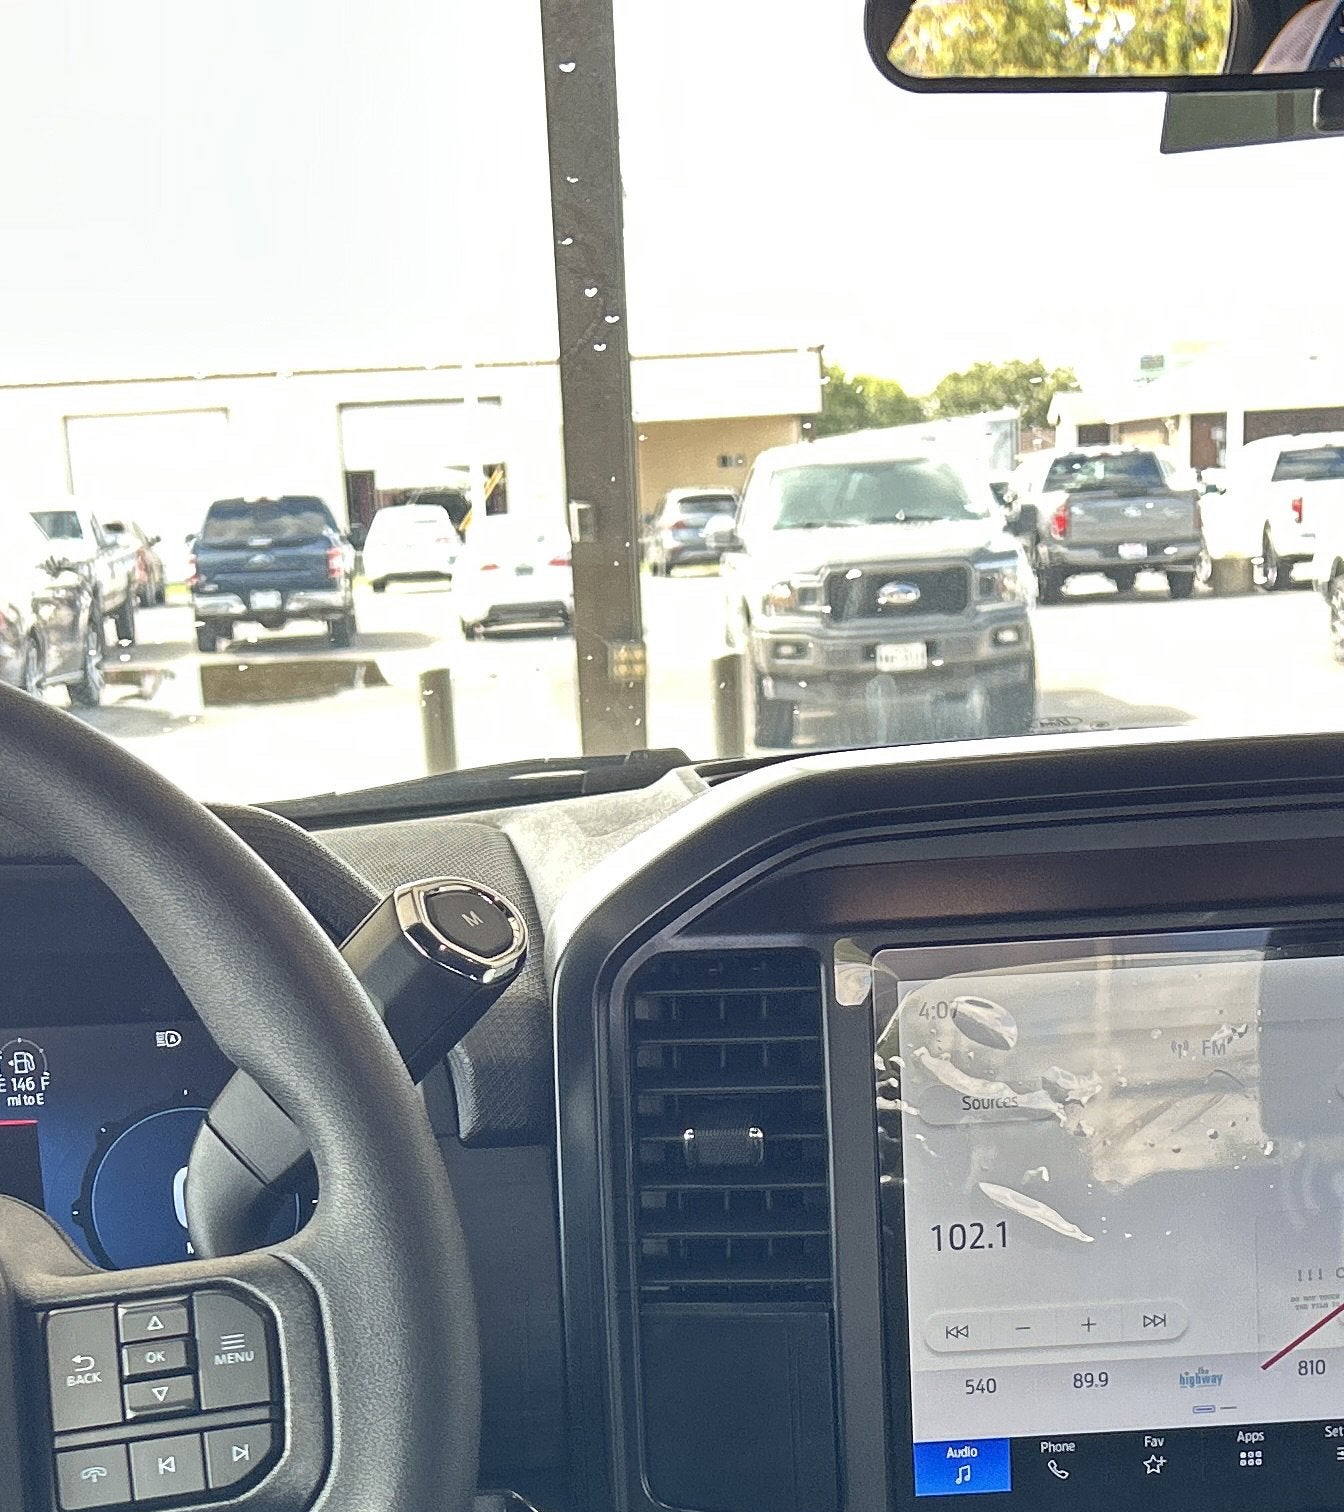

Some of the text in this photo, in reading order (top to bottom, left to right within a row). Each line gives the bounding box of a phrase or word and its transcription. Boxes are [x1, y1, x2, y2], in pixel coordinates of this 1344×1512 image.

[462, 911, 484, 927] M
[11, 1077, 35, 1091] 146
[41, 1075, 50, 1091] F
[23, 1094, 35, 1106] to
[962, 1095, 1019, 1111] Sources
[931, 1221, 1007, 1252] 102.1
[145, 1350, 165, 1363] OK
[214, 1350, 254, 1365] MENU
[1298, 1359, 1326, 1376] 810
[67, 1371, 102, 1387] BACK
[965, 1377, 997, 1395] 540
[1073, 1371, 1109, 1389] 89.9
[1179, 1372, 1223, 1388] highway
[1144, 1435, 1164, 1448] Fav
[1237, 1429, 1265, 1445] Apps
[946, 1445, 978, 1459] Audio
[1041, 1440, 1076, 1454] Phone
